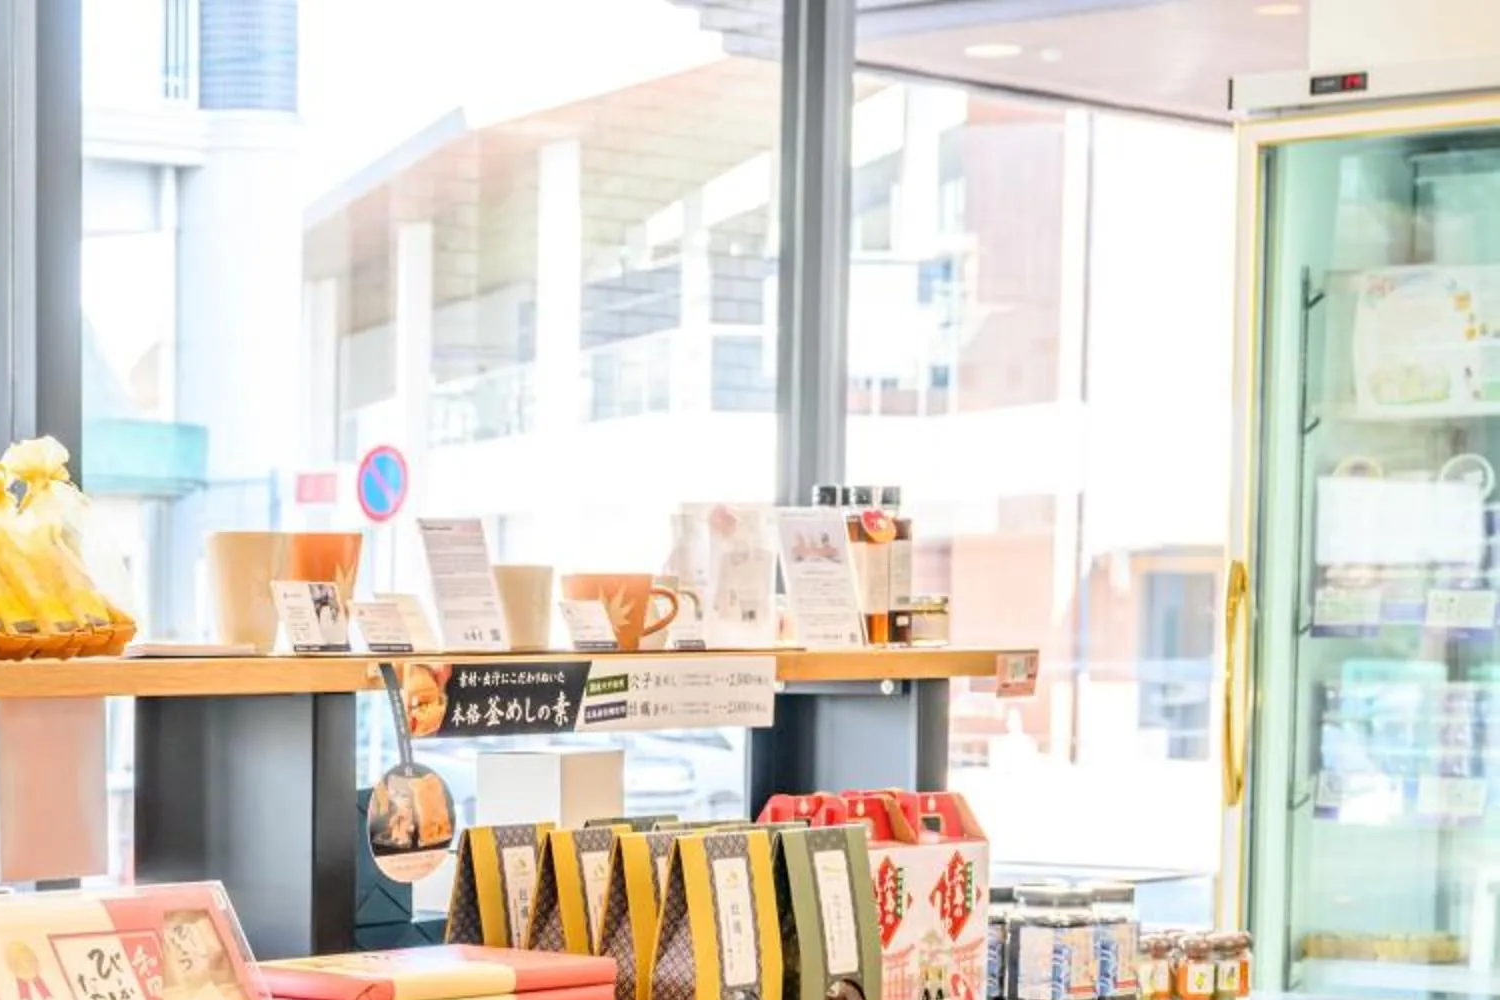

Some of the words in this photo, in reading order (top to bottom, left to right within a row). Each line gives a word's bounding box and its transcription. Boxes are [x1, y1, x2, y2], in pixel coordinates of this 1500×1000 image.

[451, 690, 572, 728] 本格釜めしの素
